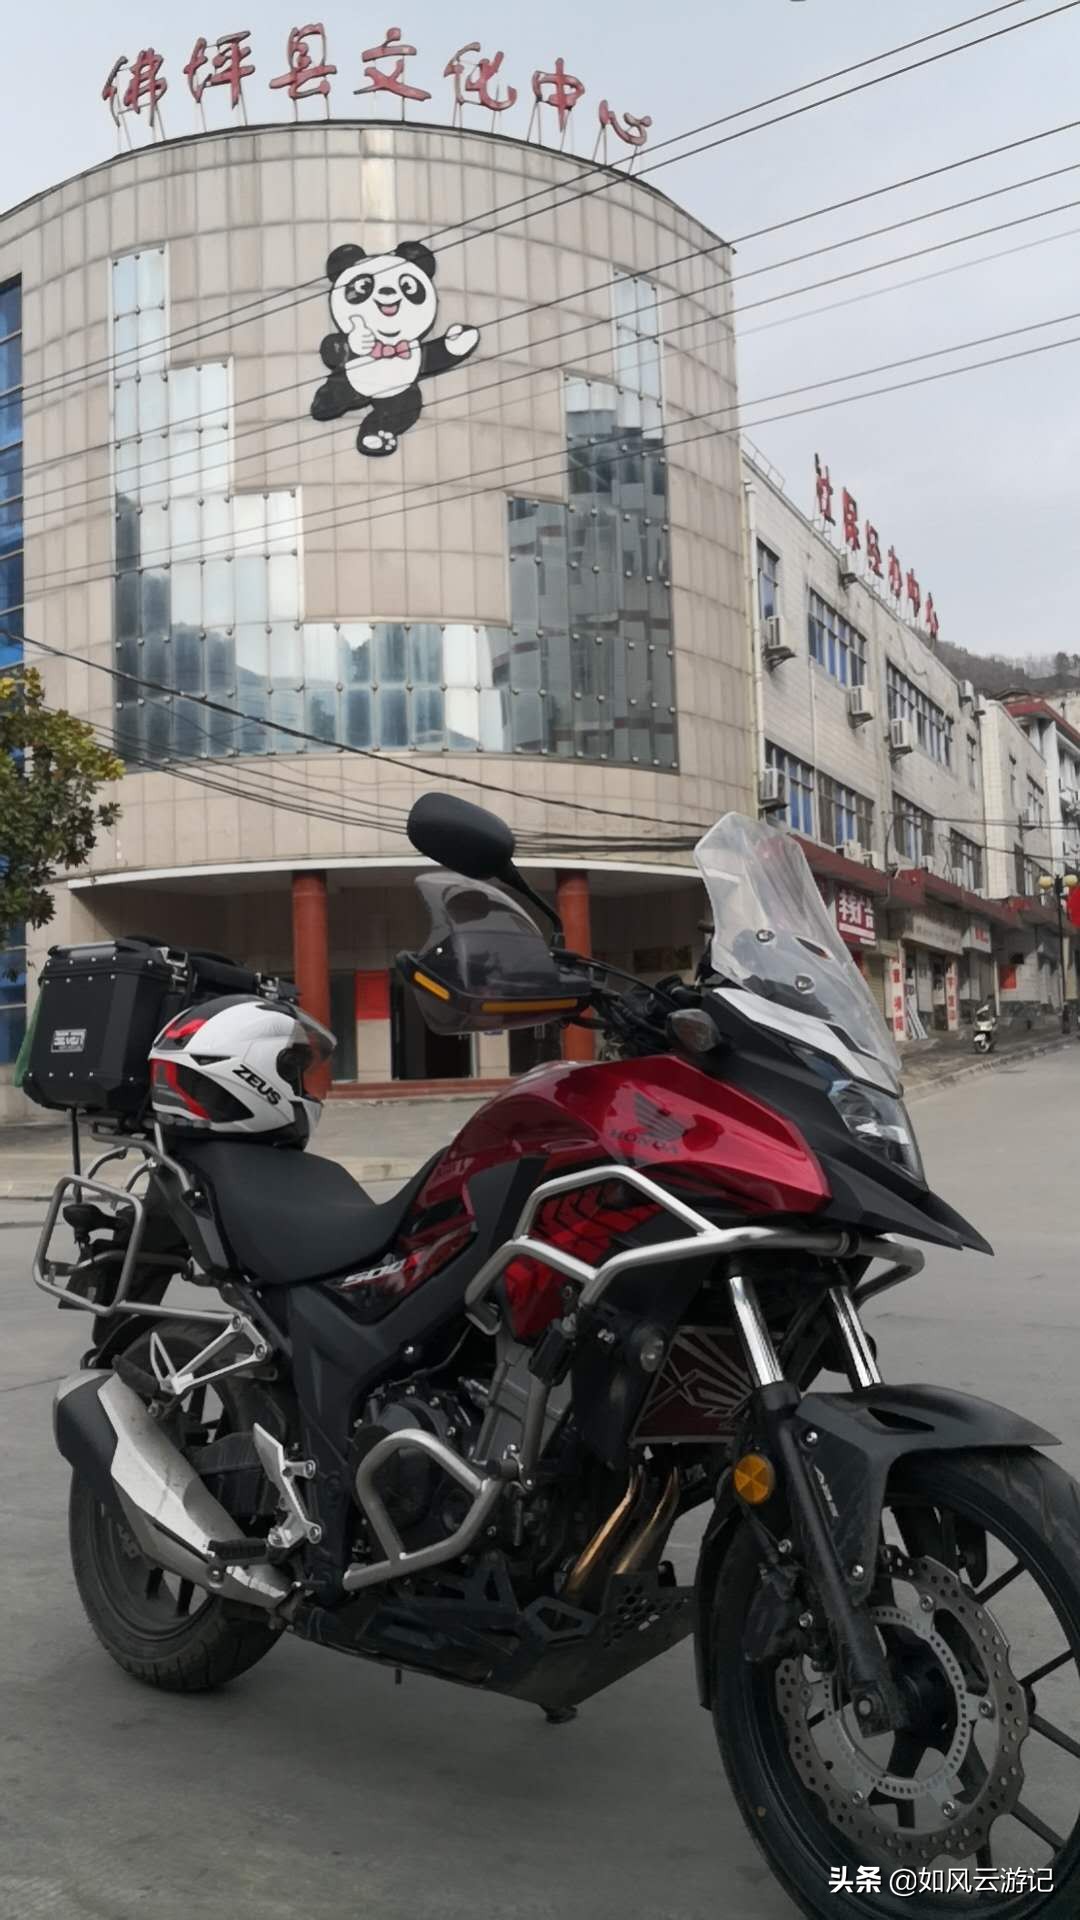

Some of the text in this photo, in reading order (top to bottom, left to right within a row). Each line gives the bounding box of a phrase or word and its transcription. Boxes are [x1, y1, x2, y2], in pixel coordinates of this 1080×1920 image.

[102, 22, 653, 145] 佛坪县文化中心
[232, 1064, 281, 1105] ZEUS
